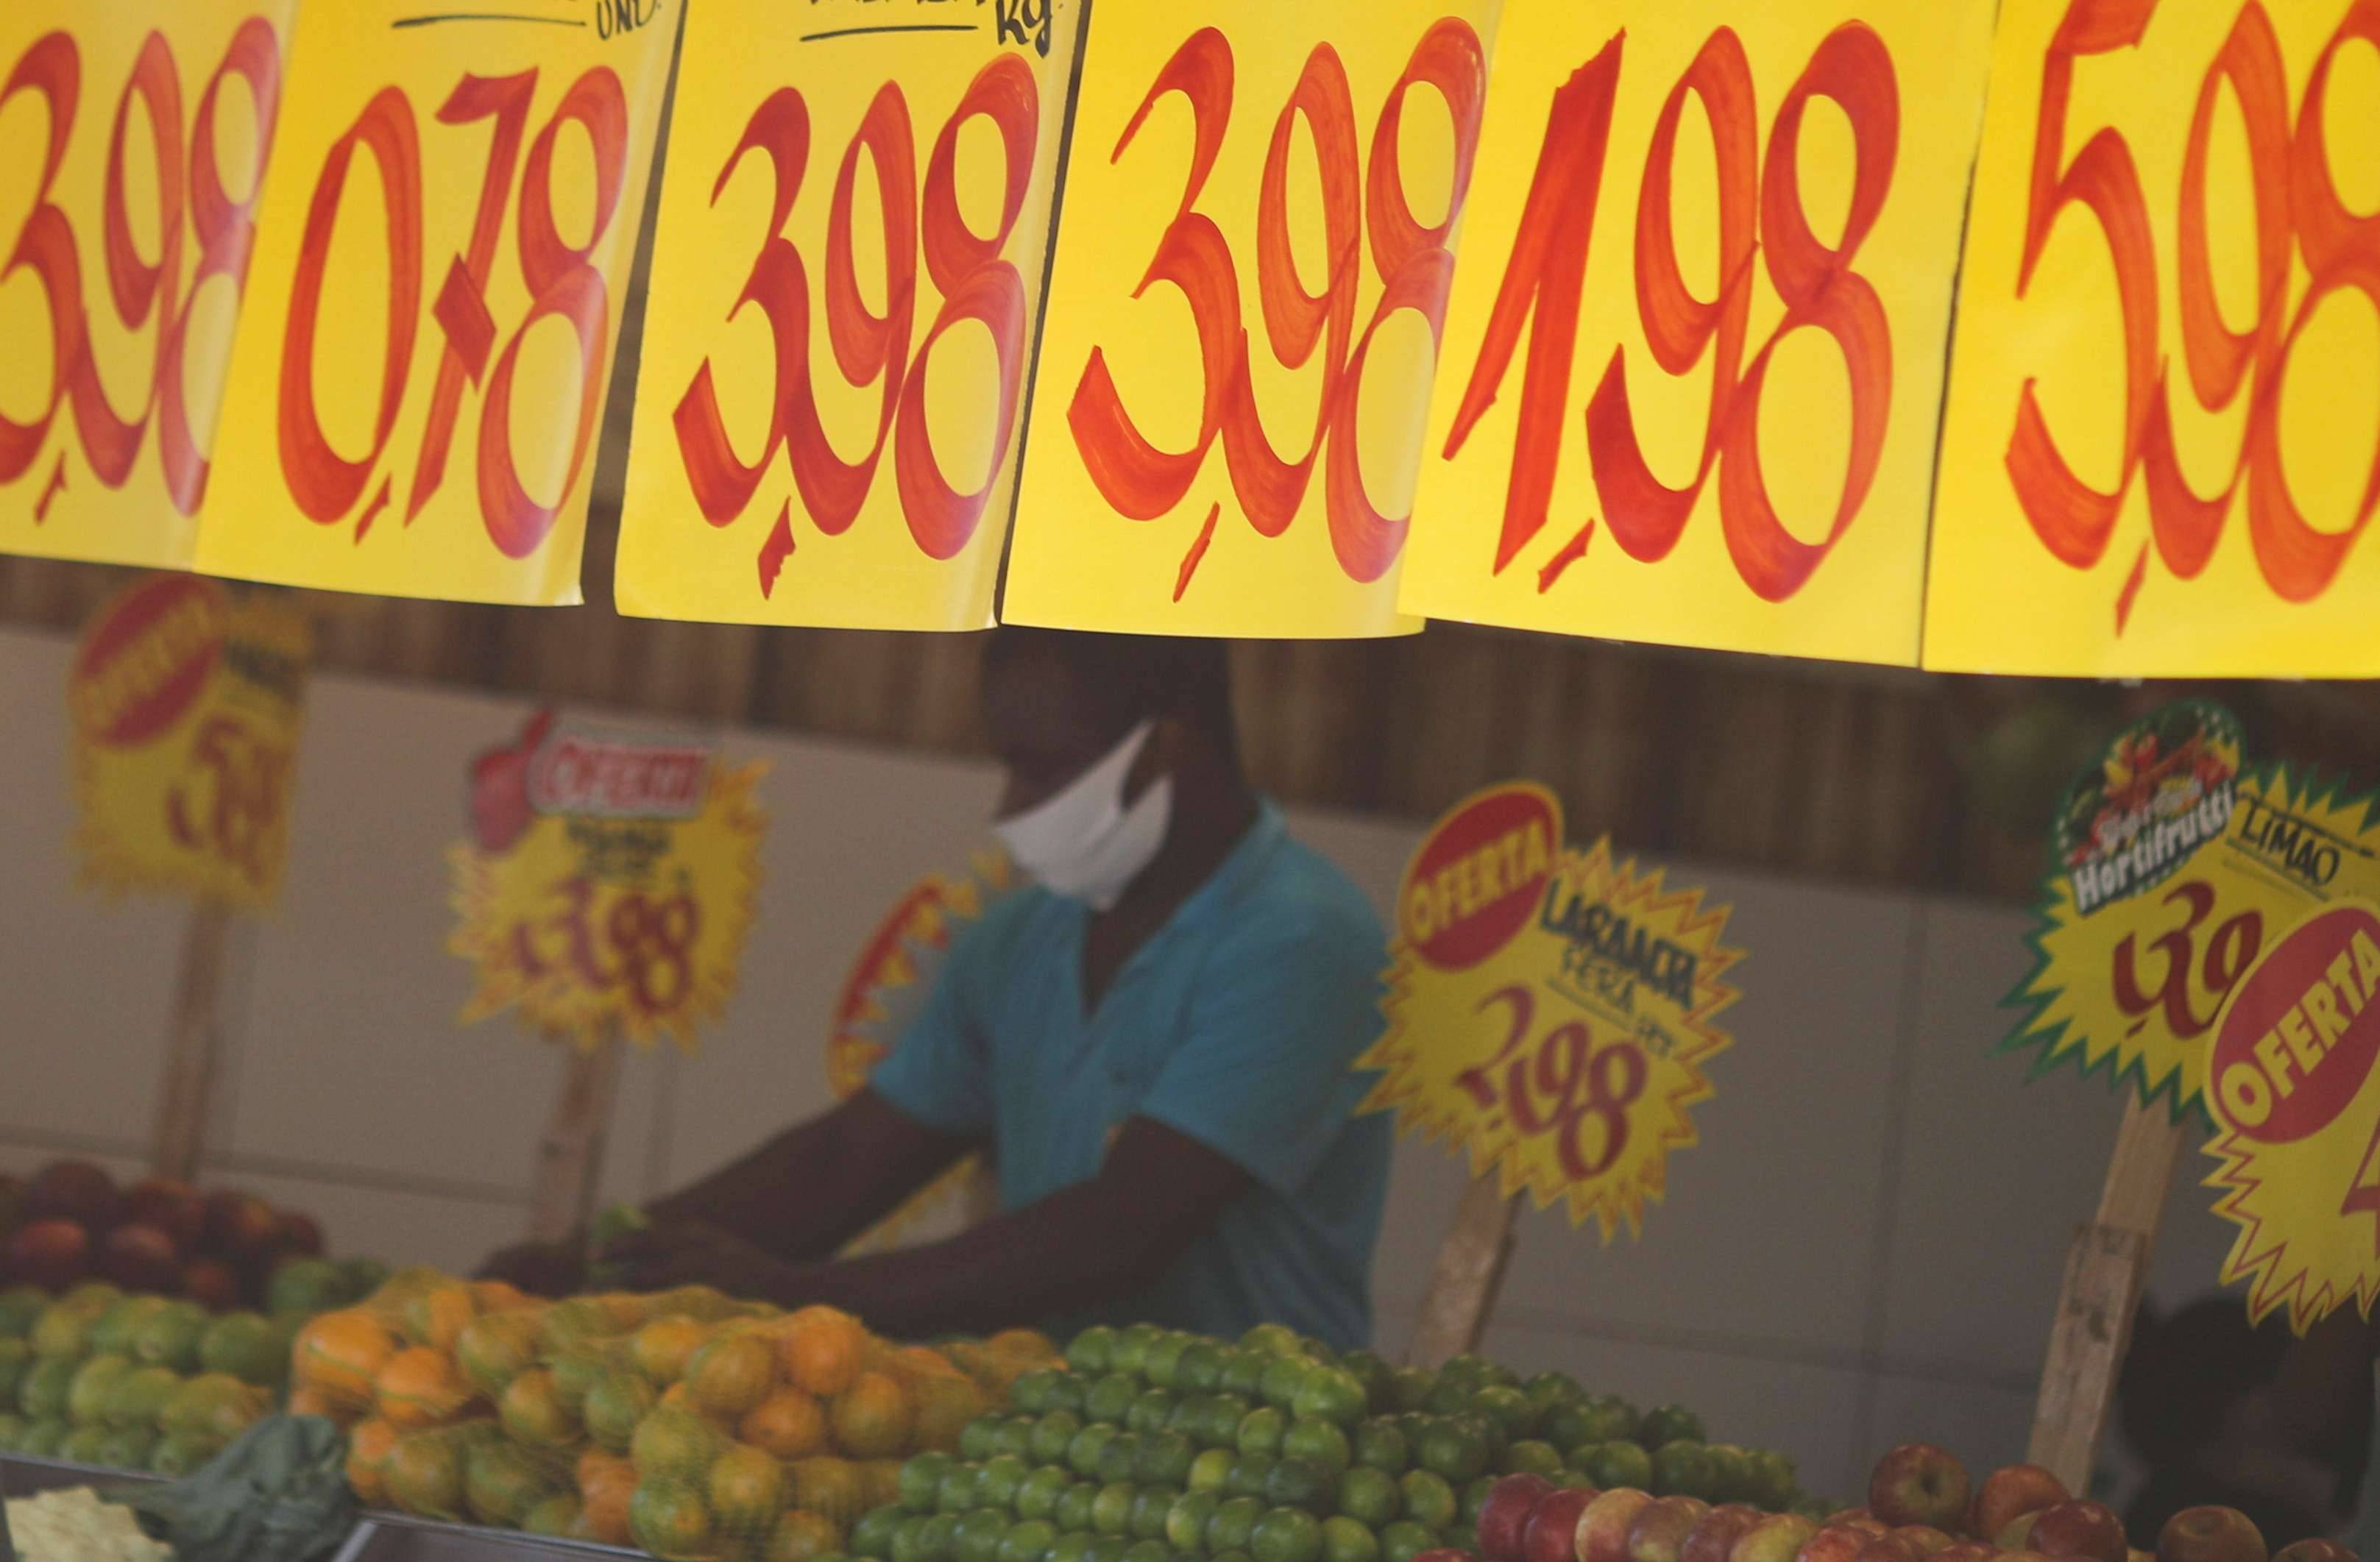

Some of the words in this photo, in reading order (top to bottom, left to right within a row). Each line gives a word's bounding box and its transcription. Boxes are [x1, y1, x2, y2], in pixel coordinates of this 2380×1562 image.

[0, 16, 280, 525] 3,98
[277, 65, 628, 560] 0,78
[673, 52, 1039, 600] 3,98
[1067, 16, 1484, 603] 3,98
[1442, 18, 1900, 603] 1,98
[2004, 0, 2380, 639] 5,98
[1412, 818, 1547, 945] OFERTA
[1453, 984, 1648, 1182] 2,98
[2074, 778, 2234, 915] Hortifrutti
[2220, 928, 2380, 1127] OFERTA
